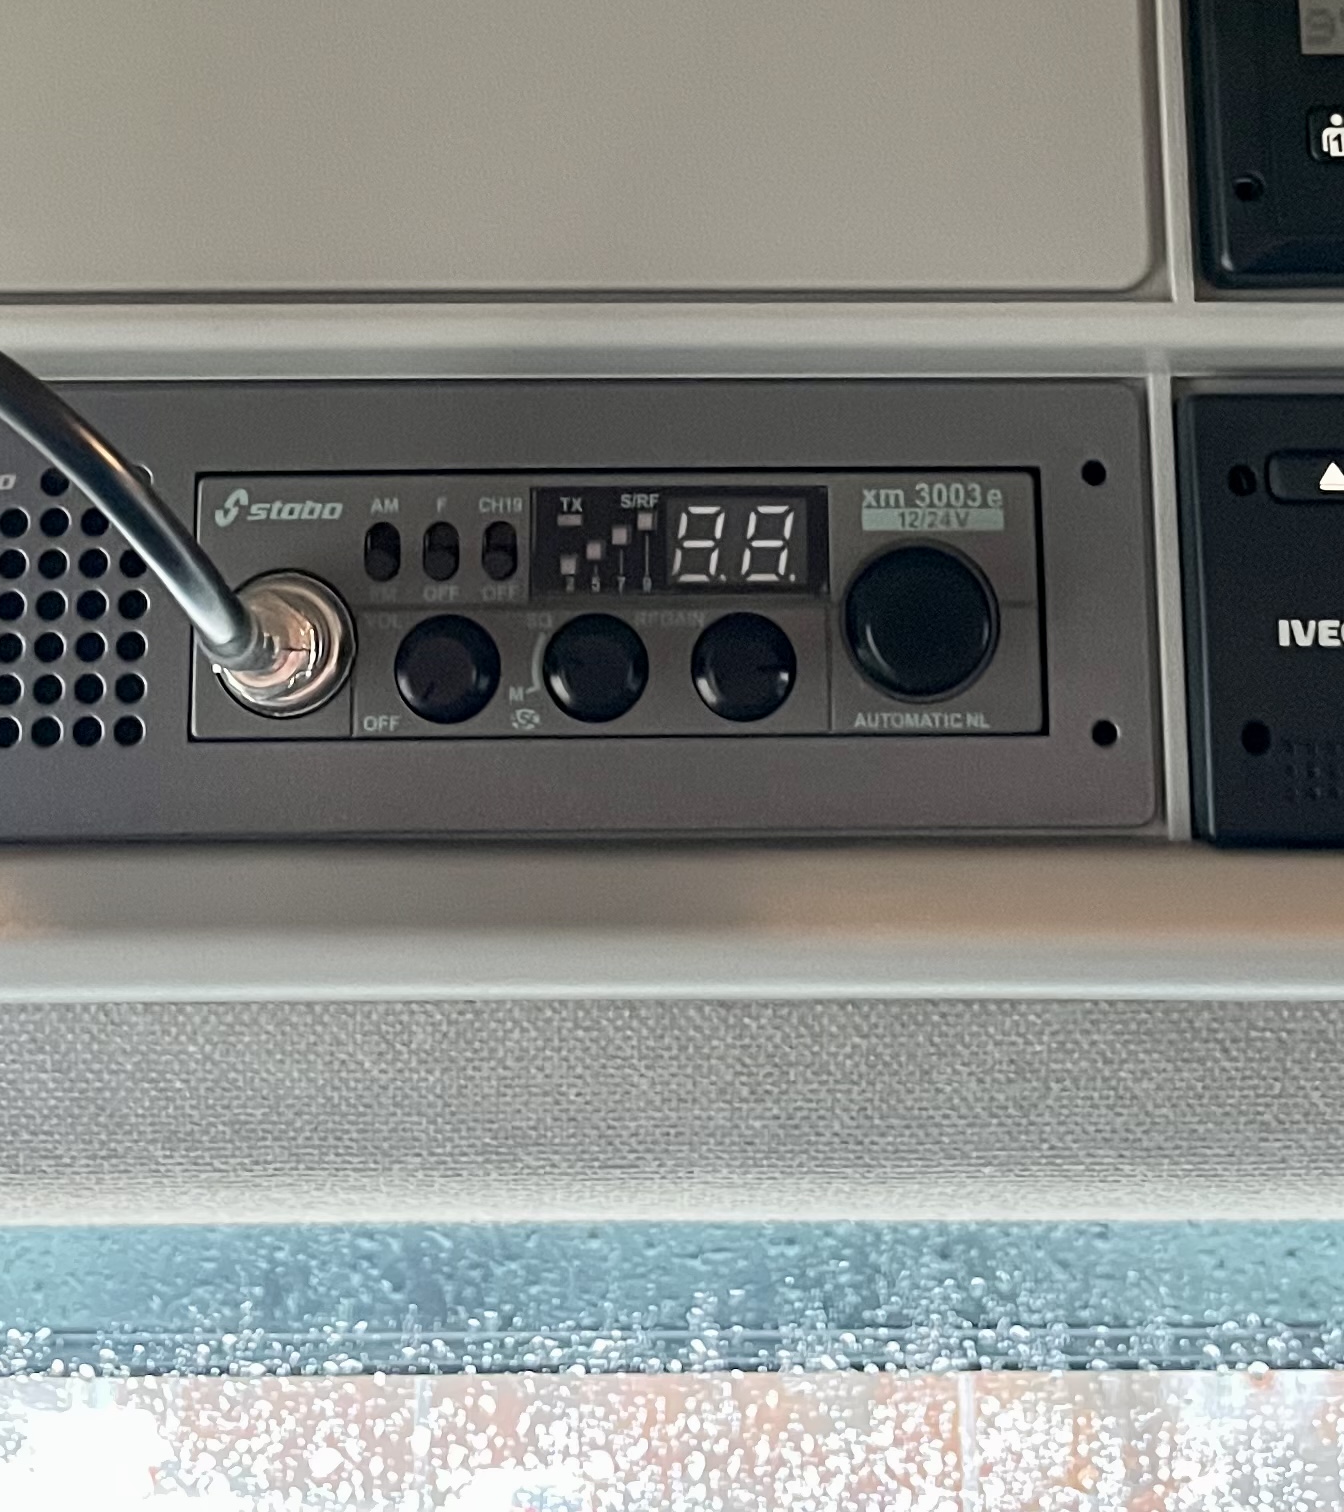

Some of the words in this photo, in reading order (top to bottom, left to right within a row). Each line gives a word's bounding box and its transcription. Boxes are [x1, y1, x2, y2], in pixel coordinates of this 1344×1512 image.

[370, 498, 399, 513] AM
[560, 497, 583, 512] TX
[620, 494, 660, 509] S/RF
[862, 488, 905, 507] xm
[247, 498, 343, 521] stabo
[423, 585, 460, 601] OFF
[480, 585, 517, 601] OFF
[509, 687, 524, 704] M
[363, 715, 401, 732] OFF
[854, 712, 963, 729] AUTOMATIC
[966, 712, 991, 729] NL
